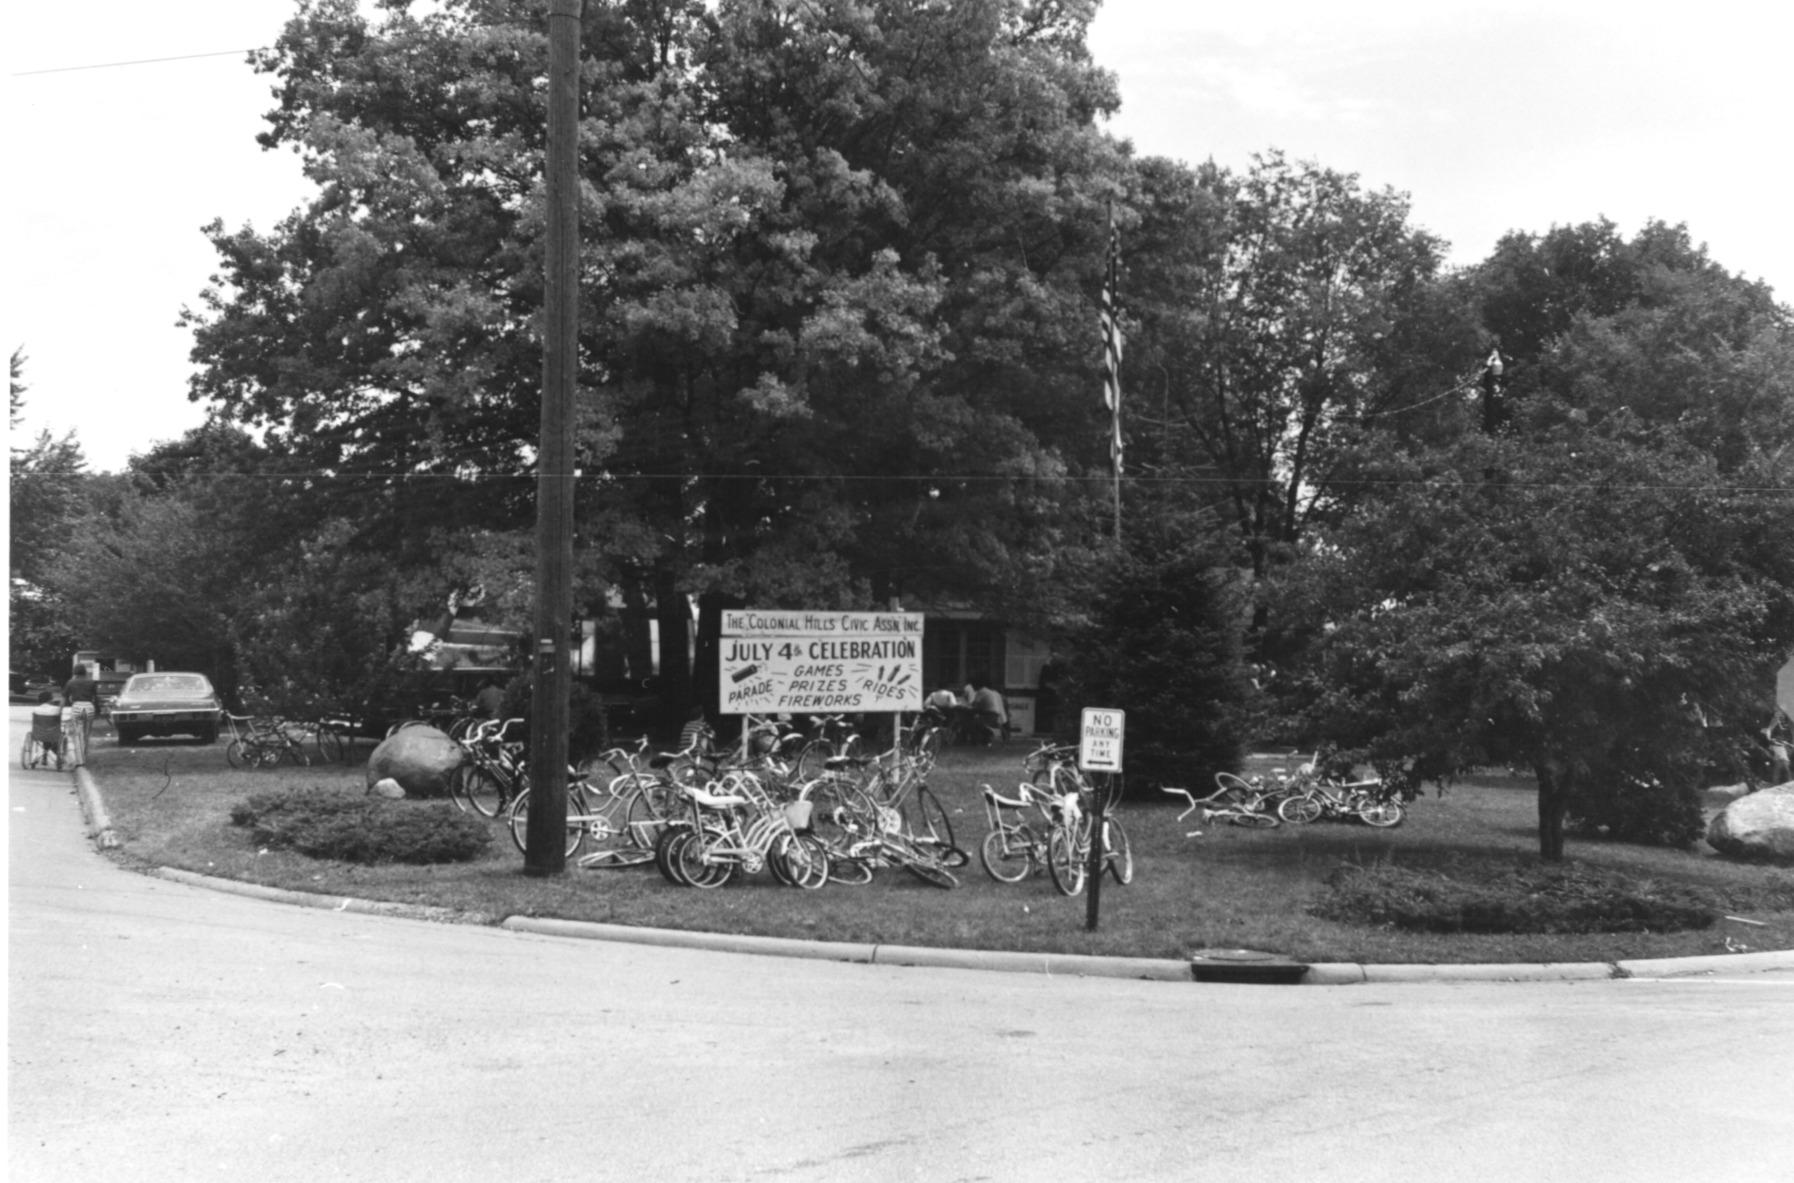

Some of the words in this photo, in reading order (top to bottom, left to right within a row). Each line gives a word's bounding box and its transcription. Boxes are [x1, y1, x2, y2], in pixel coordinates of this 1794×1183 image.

[727, 613, 744, 629] THE
[749, 613, 800, 630] COLONIAL
[805, 614, 835, 631] HILLS
[841, 615, 869, 631] CIVIC
[726, 642, 773, 661] JULY
[809, 641, 915, 660] CELEBRATION
[794, 664, 845, 677] GAMES
[728, 679, 773, 704] PARADE
[788, 679, 848, 692] PRIZES
[862, 679, 906, 700] RIDES
[777, 693, 862, 707] FIREWORKS
[1093, 715, 1112, 727] NO
[1086, 726, 1119, 739] PARKING
[1091, 749, 1110, 758] TIME
